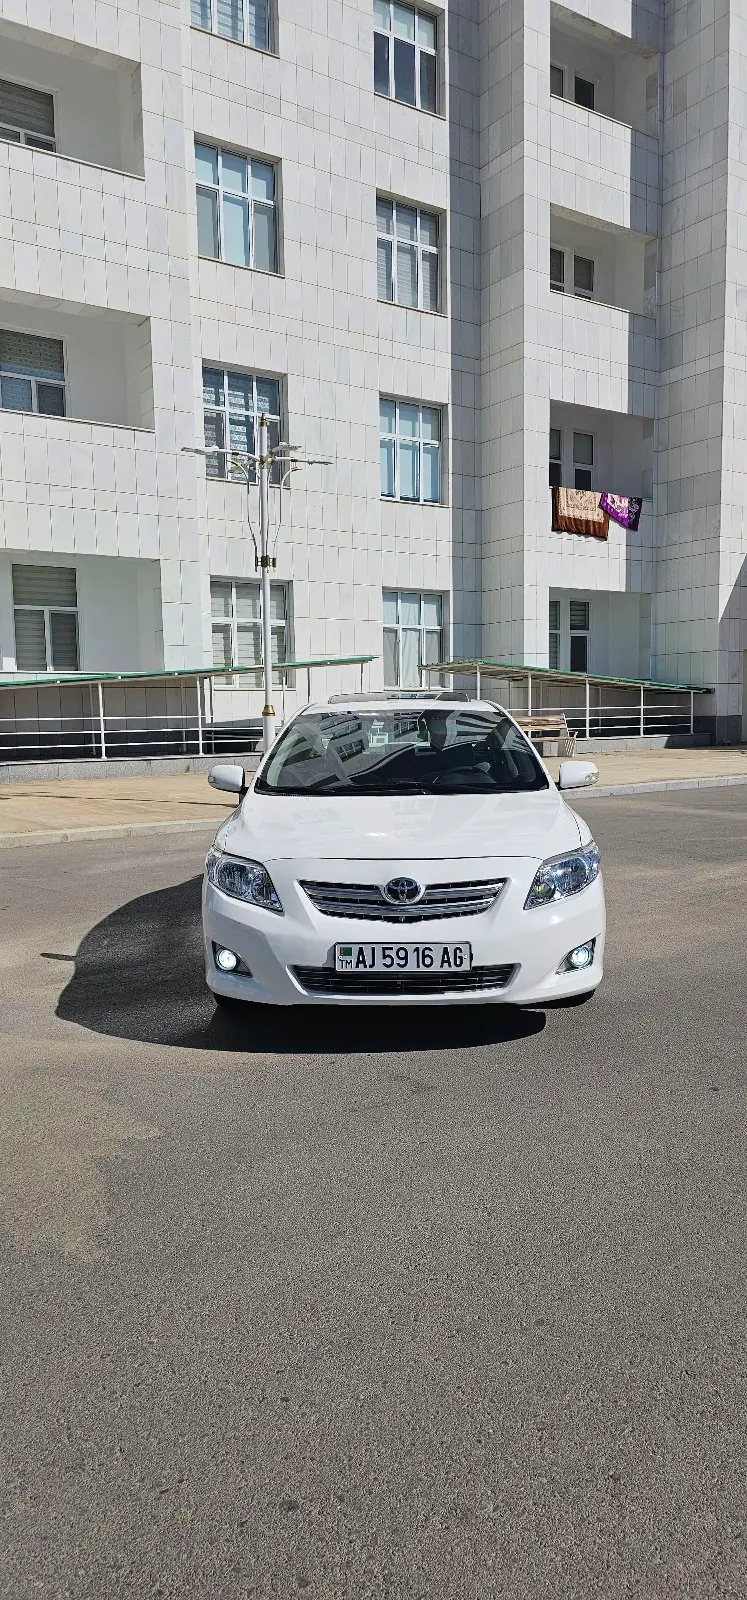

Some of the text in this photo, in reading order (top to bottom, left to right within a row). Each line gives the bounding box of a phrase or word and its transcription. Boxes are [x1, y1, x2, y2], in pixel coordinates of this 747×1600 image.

[340, 959, 353, 969] TM
[355, 946, 376, 968] AJ
[439, 946, 464, 968] AG
